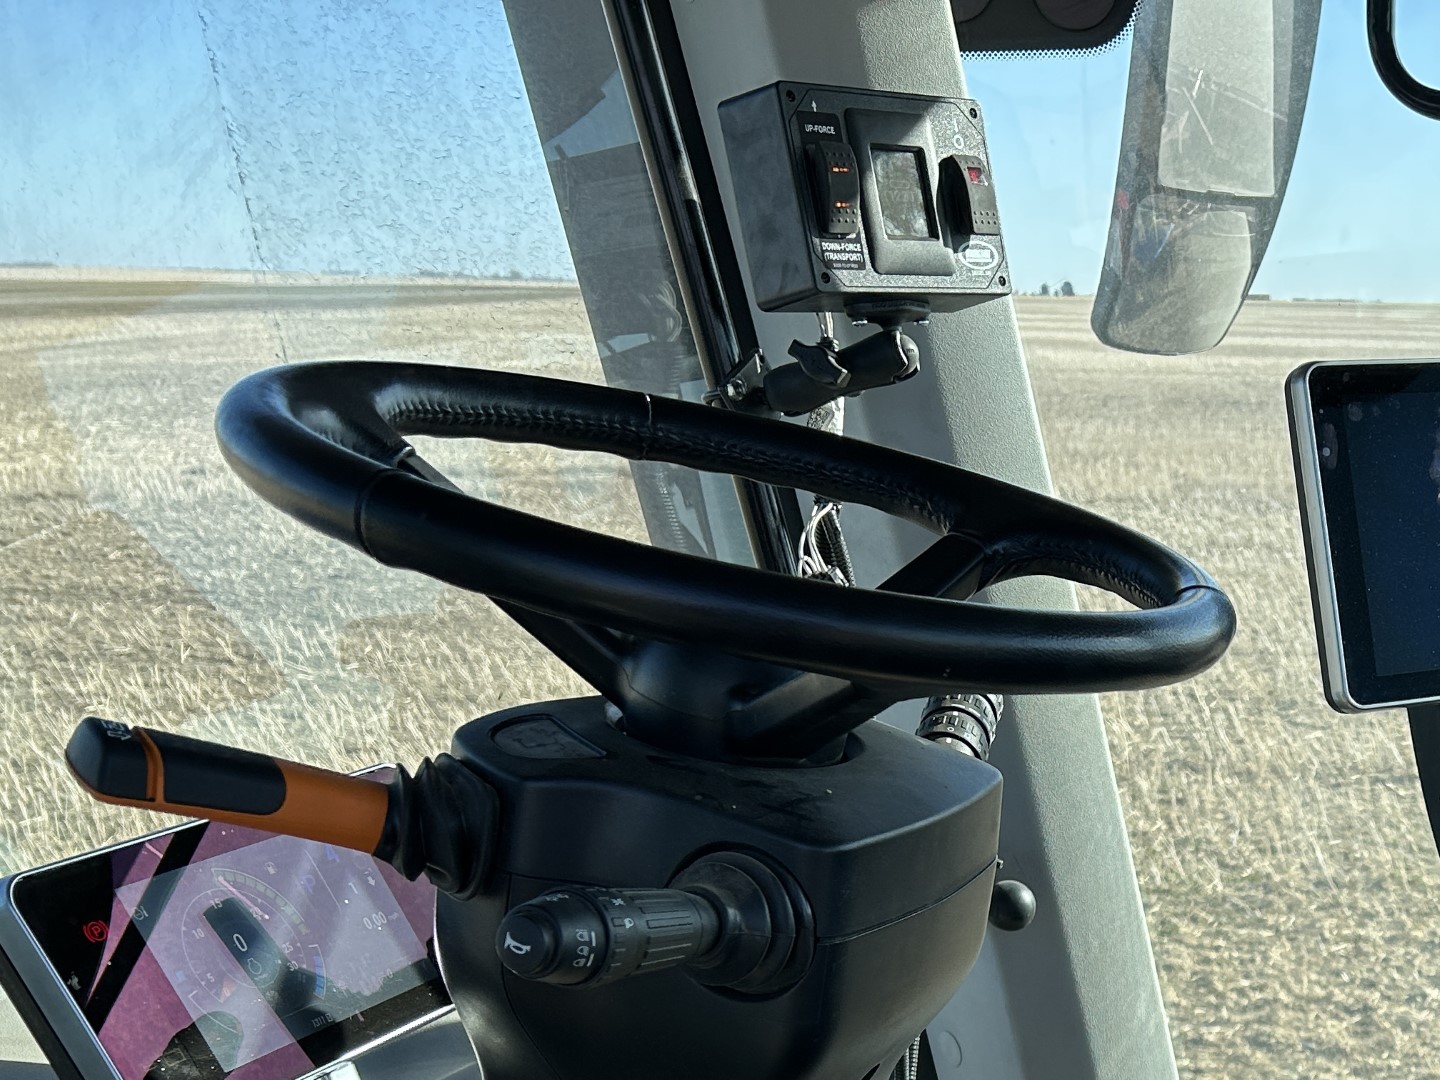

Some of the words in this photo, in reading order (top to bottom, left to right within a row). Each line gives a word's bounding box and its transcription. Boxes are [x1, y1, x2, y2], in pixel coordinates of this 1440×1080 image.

[804, 123, 836, 135] UP-FORCE
[821, 242, 862, 252] DOWN-FORCE
[824, 252, 864, 263] (TRANSPORT)
[209, 897, 223, 909] 15
[362, 911, 388, 930] 0.00
[191, 928, 205, 939] 10
[232, 933, 248, 952] 0
[282, 943, 294, 954] 25
[287, 960, 299, 972] 30
